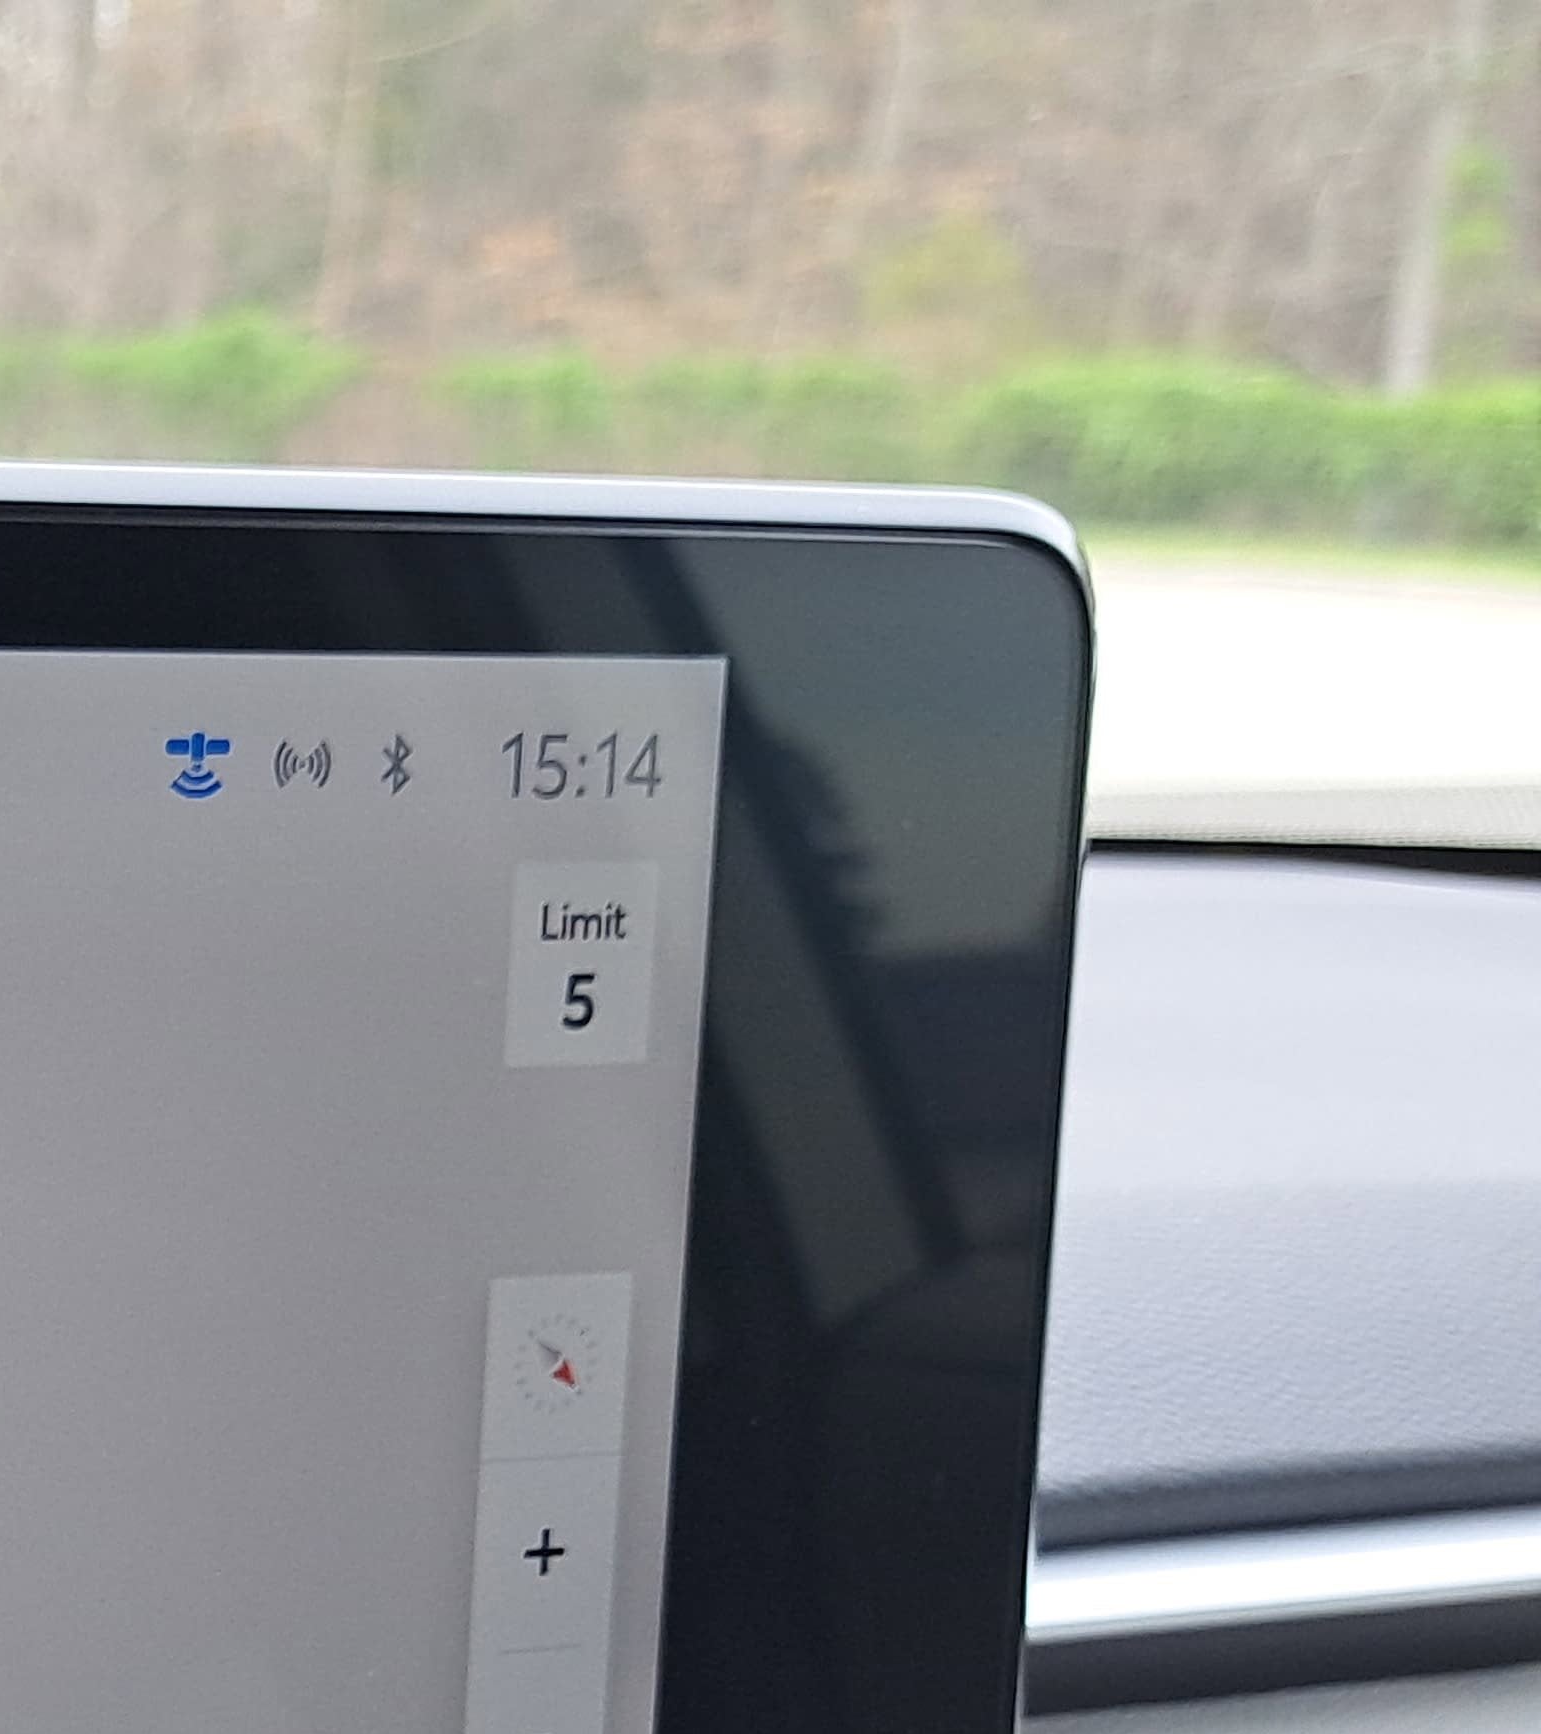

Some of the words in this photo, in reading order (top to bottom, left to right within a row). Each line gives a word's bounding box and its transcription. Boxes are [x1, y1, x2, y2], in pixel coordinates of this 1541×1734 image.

[502, 732, 663, 800] 15:14
[540, 903, 627, 942] Limit
[561, 973, 596, 1031] 5
